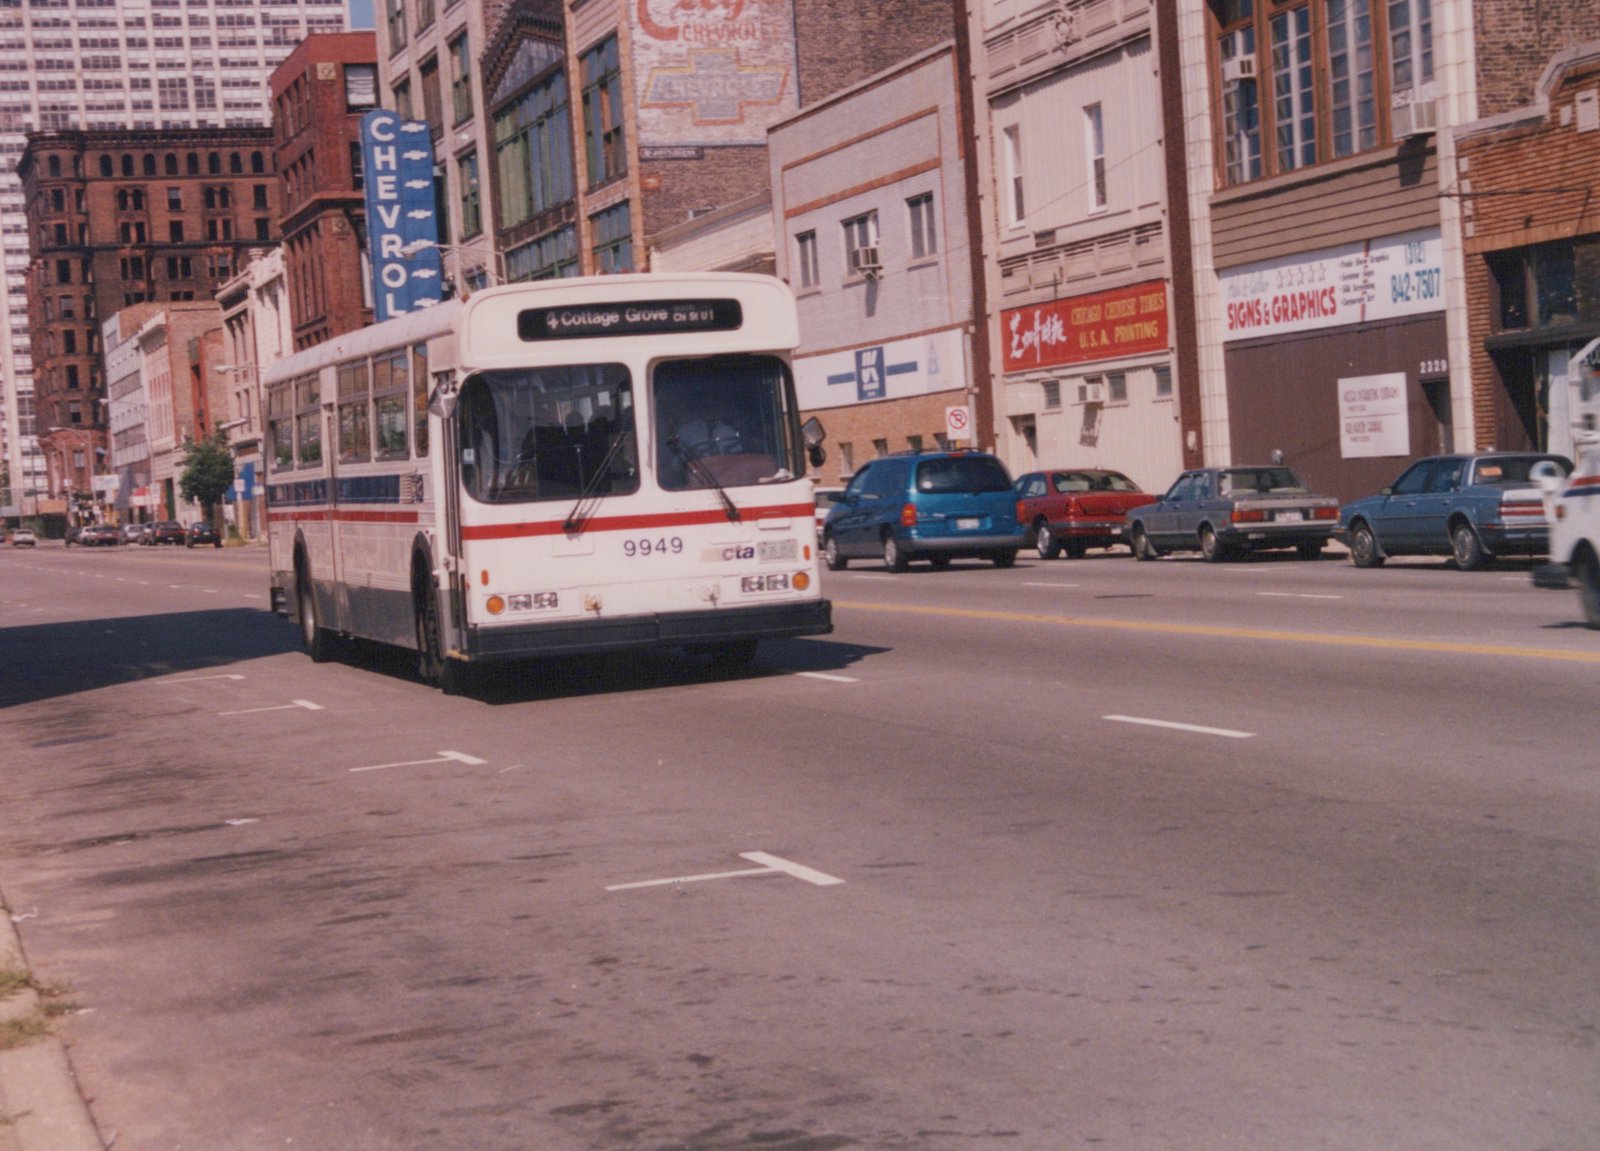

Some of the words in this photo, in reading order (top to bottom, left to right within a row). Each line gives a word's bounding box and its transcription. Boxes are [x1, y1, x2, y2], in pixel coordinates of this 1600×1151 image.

[1405, 241, 1426, 265] (312)
[1391, 267, 1440, 303] 842-7507
[546, 311, 559, 330] 4
[561, 310, 621, 328] Cottage
[625, 307, 668, 323] Grove
[1071, 304, 1102, 325] CHICAGO
[1105, 298, 1137, 320] CHINESE
[1140, 292, 1165, 314] TIMES
[1227, 298, 1262, 331] SIGNS
[1264, 303, 1271, 326] &
[1272, 286, 1337, 324] GRAPHICS
[1114, 320, 1159, 343] PRINTING
[1420, 360, 1447, 374] 2329
[623, 537, 684, 557] 9949
[722, 545, 755, 561] cta
